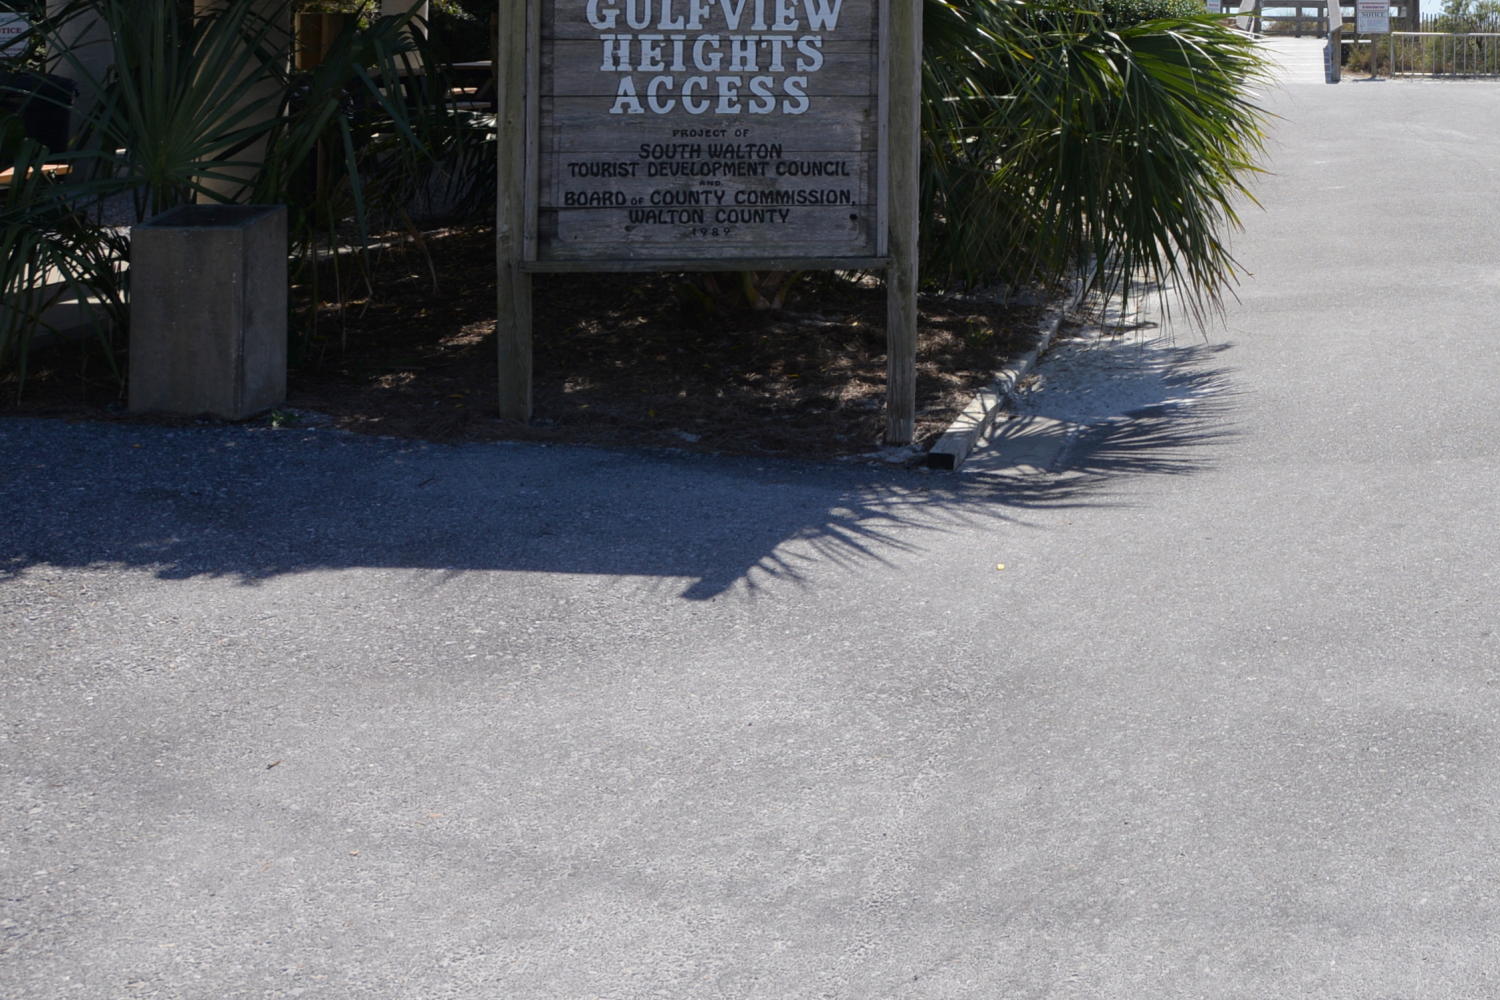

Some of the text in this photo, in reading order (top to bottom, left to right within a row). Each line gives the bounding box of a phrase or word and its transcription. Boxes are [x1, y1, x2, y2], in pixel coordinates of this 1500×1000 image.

[600, 34, 824, 72] HEIGHTS
[609, 75, 810, 114] ACCESS
[672, 129, 750, 137] PROJECT OF
[639, 143, 783, 159] SOUTH WALTON
[568, 161, 850, 177] TOURIST DEVELOPMENT COUNCIL
[564, 191, 627, 206] BOARD
[650, 190, 726, 205] COUNTY
[734, 189, 857, 206] COMMISSION,
[628, 208, 790, 224] WALTON COUNTY
[692, 227, 731, 236] 1989
